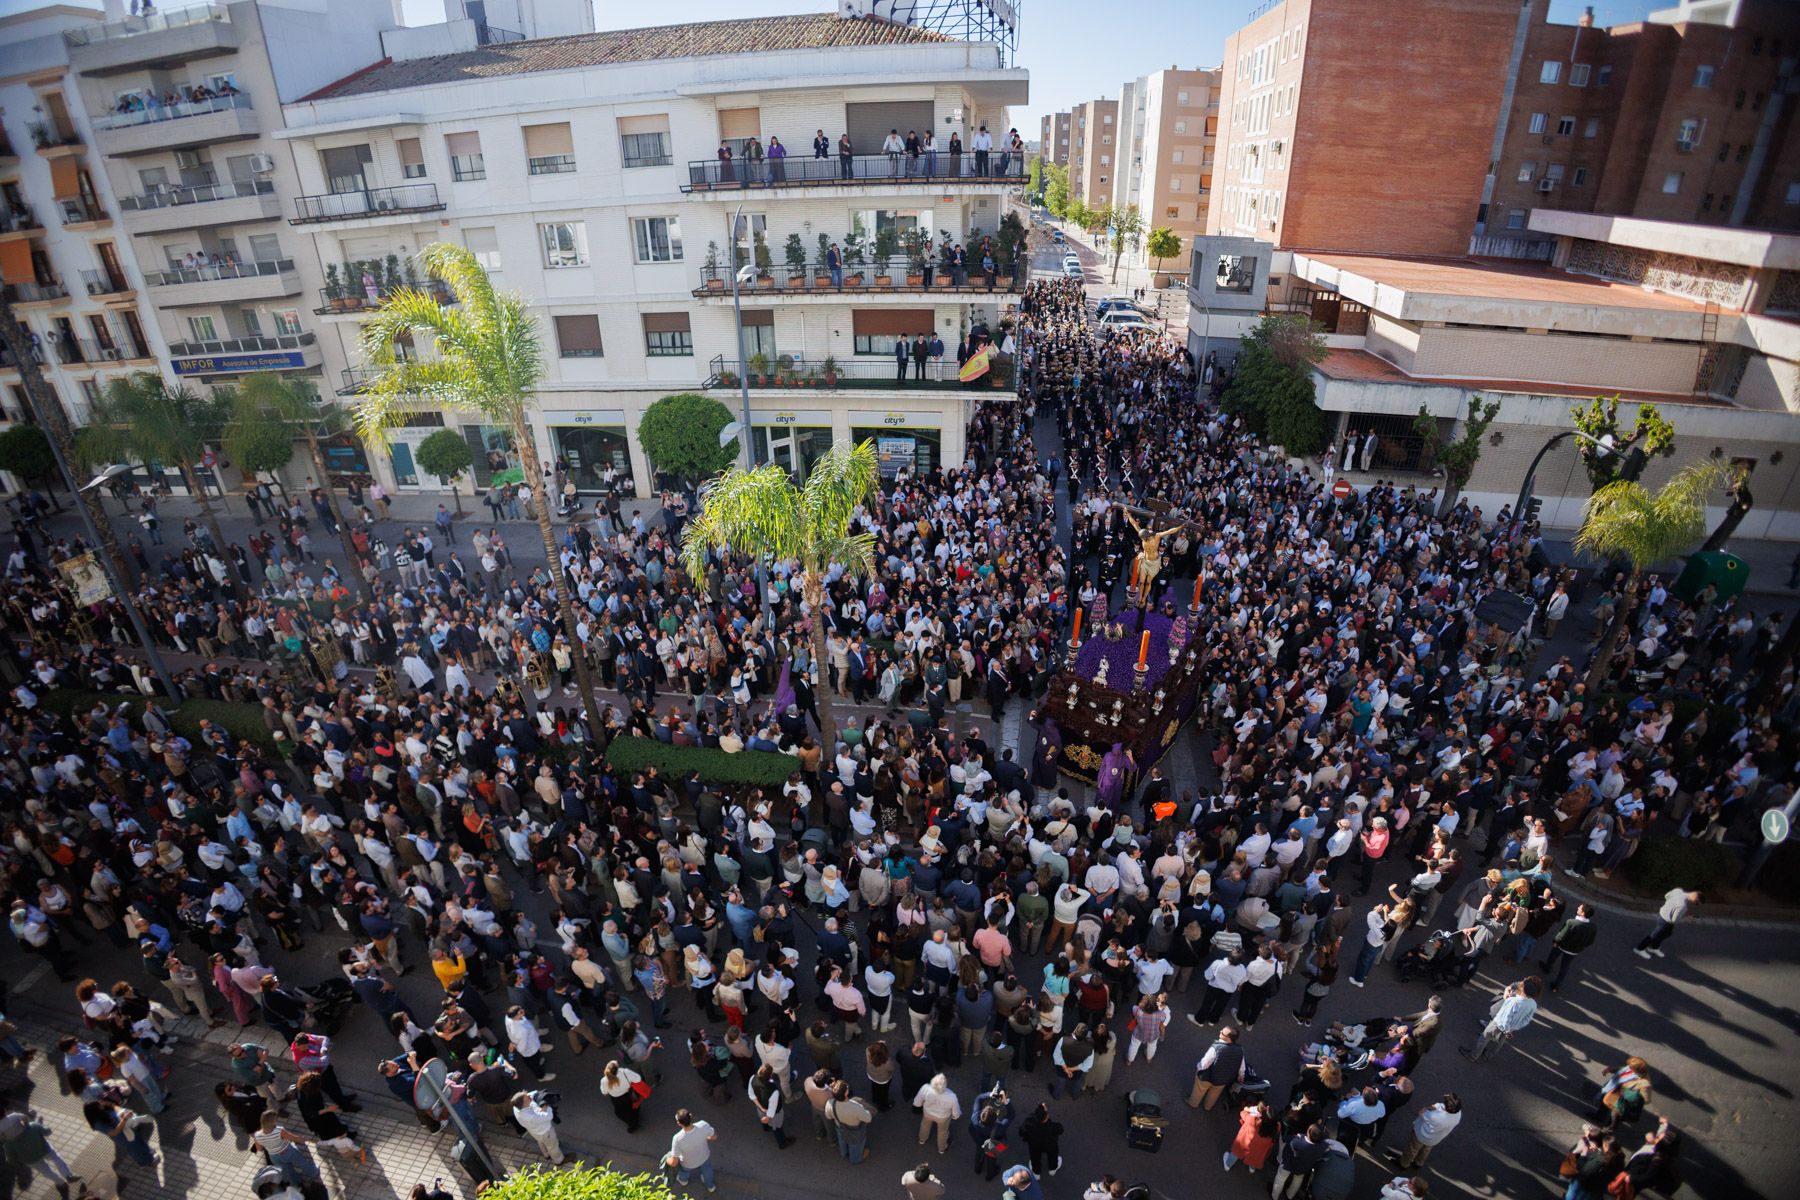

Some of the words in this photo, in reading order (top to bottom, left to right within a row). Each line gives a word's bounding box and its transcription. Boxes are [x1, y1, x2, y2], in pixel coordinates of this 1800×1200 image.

[179, 359, 215, 370] IMFOR
[775, 416, 796, 424] city10
[884, 417, 905, 425] city10
